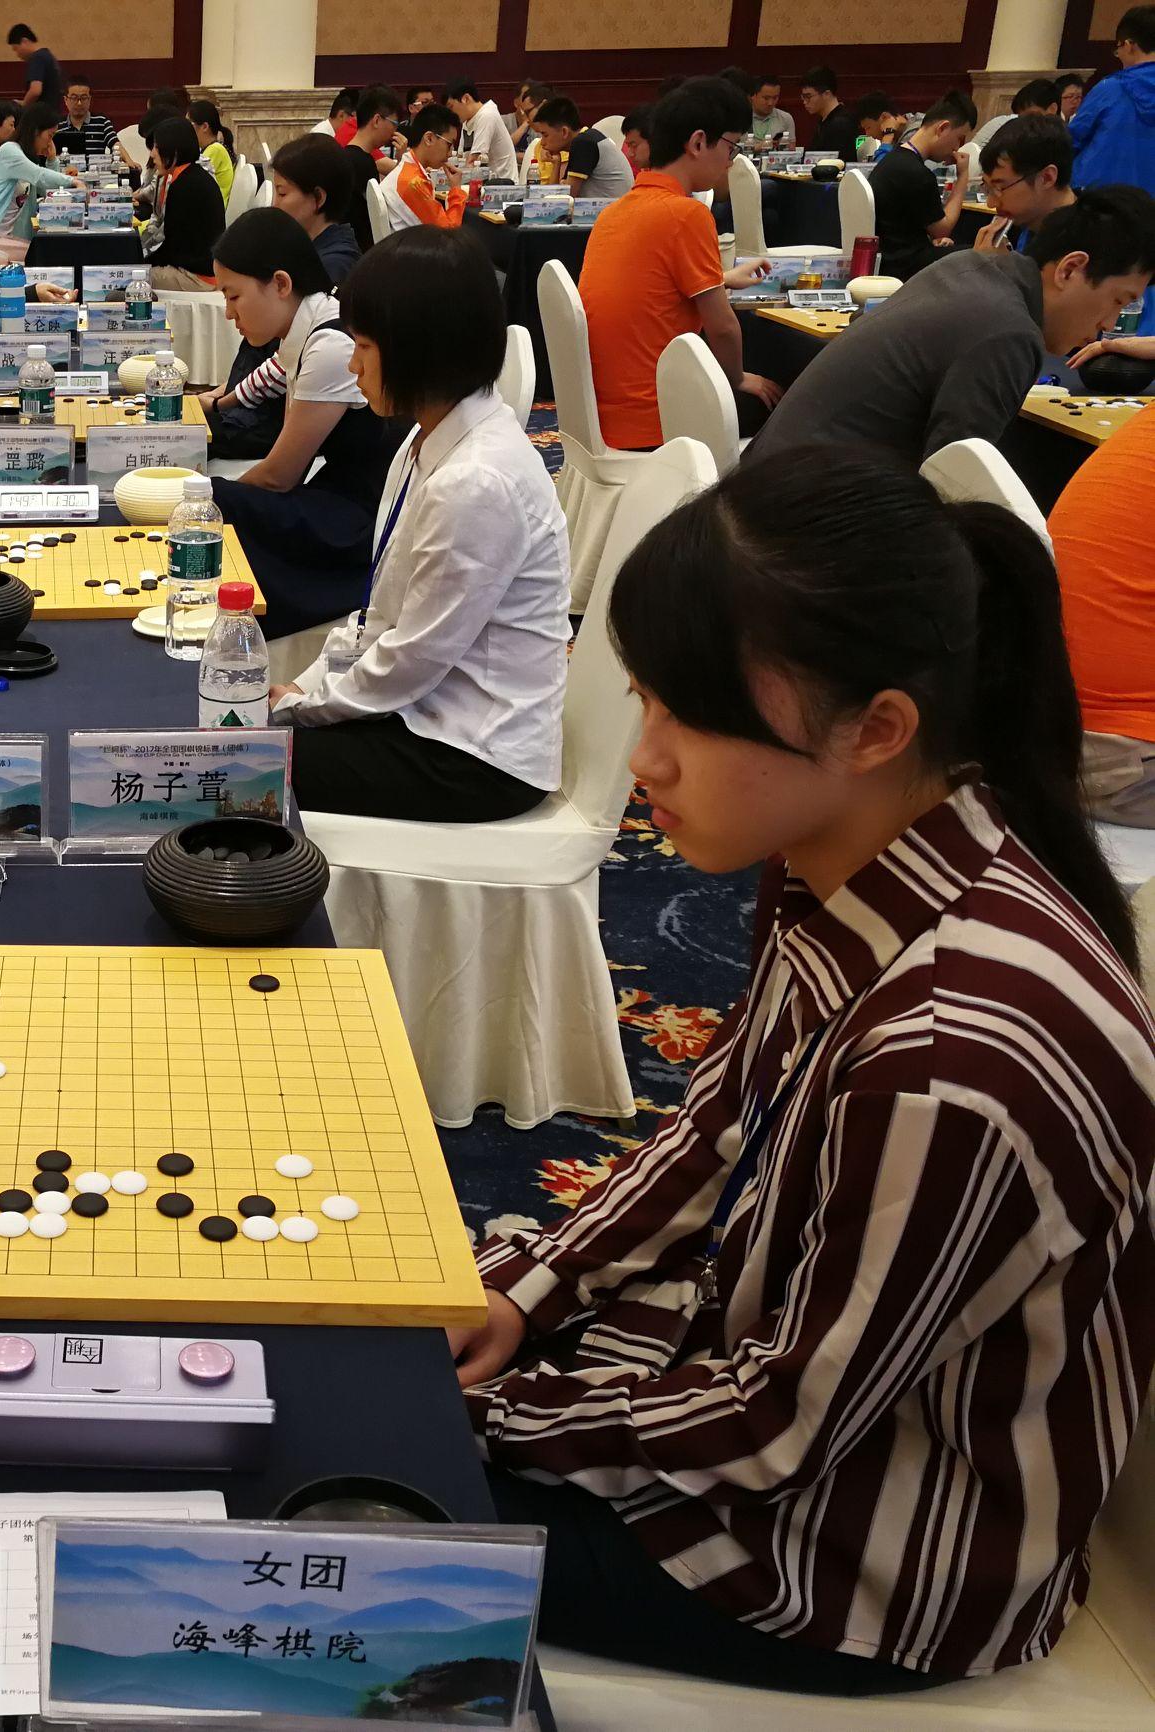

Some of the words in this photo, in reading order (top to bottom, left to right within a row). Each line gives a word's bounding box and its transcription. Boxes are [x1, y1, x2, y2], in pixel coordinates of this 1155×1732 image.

[109, 271, 124, 279] 女团
[110, 771, 228, 804] 杨子萱
[242, 1551, 347, 1592] 女团
[172, 1620, 367, 1663] 海峰棋院
